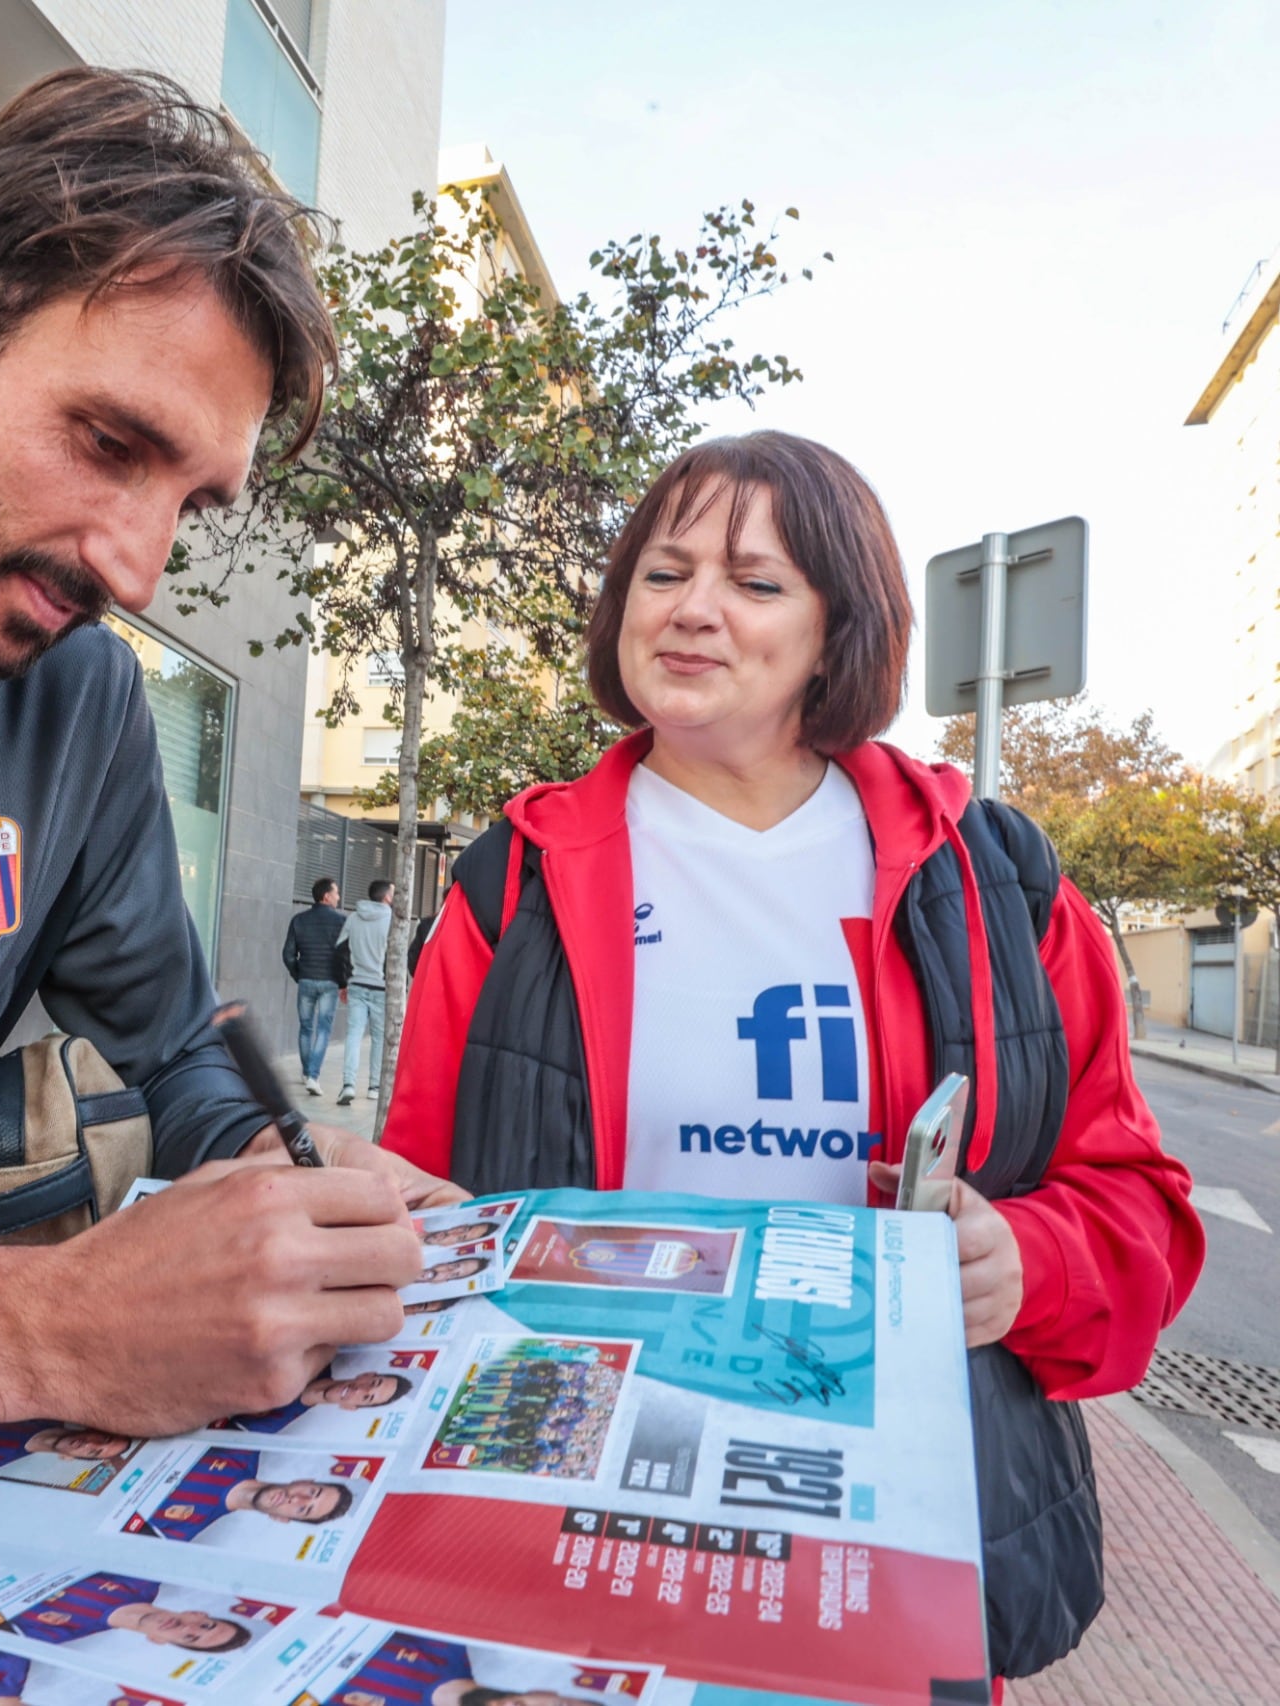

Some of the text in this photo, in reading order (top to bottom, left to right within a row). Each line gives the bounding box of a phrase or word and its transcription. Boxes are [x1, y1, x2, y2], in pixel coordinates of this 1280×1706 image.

[634, 931, 662, 945] mel
[736, 984, 859, 1103] fi
[679, 1118, 883, 1161] networ
[754, 1226, 855, 1310] ELDENSE
[720, 1437, 845, 1519] 1921
[610, 1540, 641, 1597] 2020-21
[656, 1547, 688, 1605] 2021-22
[705, 1527, 736, 1616] 2º 2022-23
[757, 1558, 787, 1624] 2023-24
